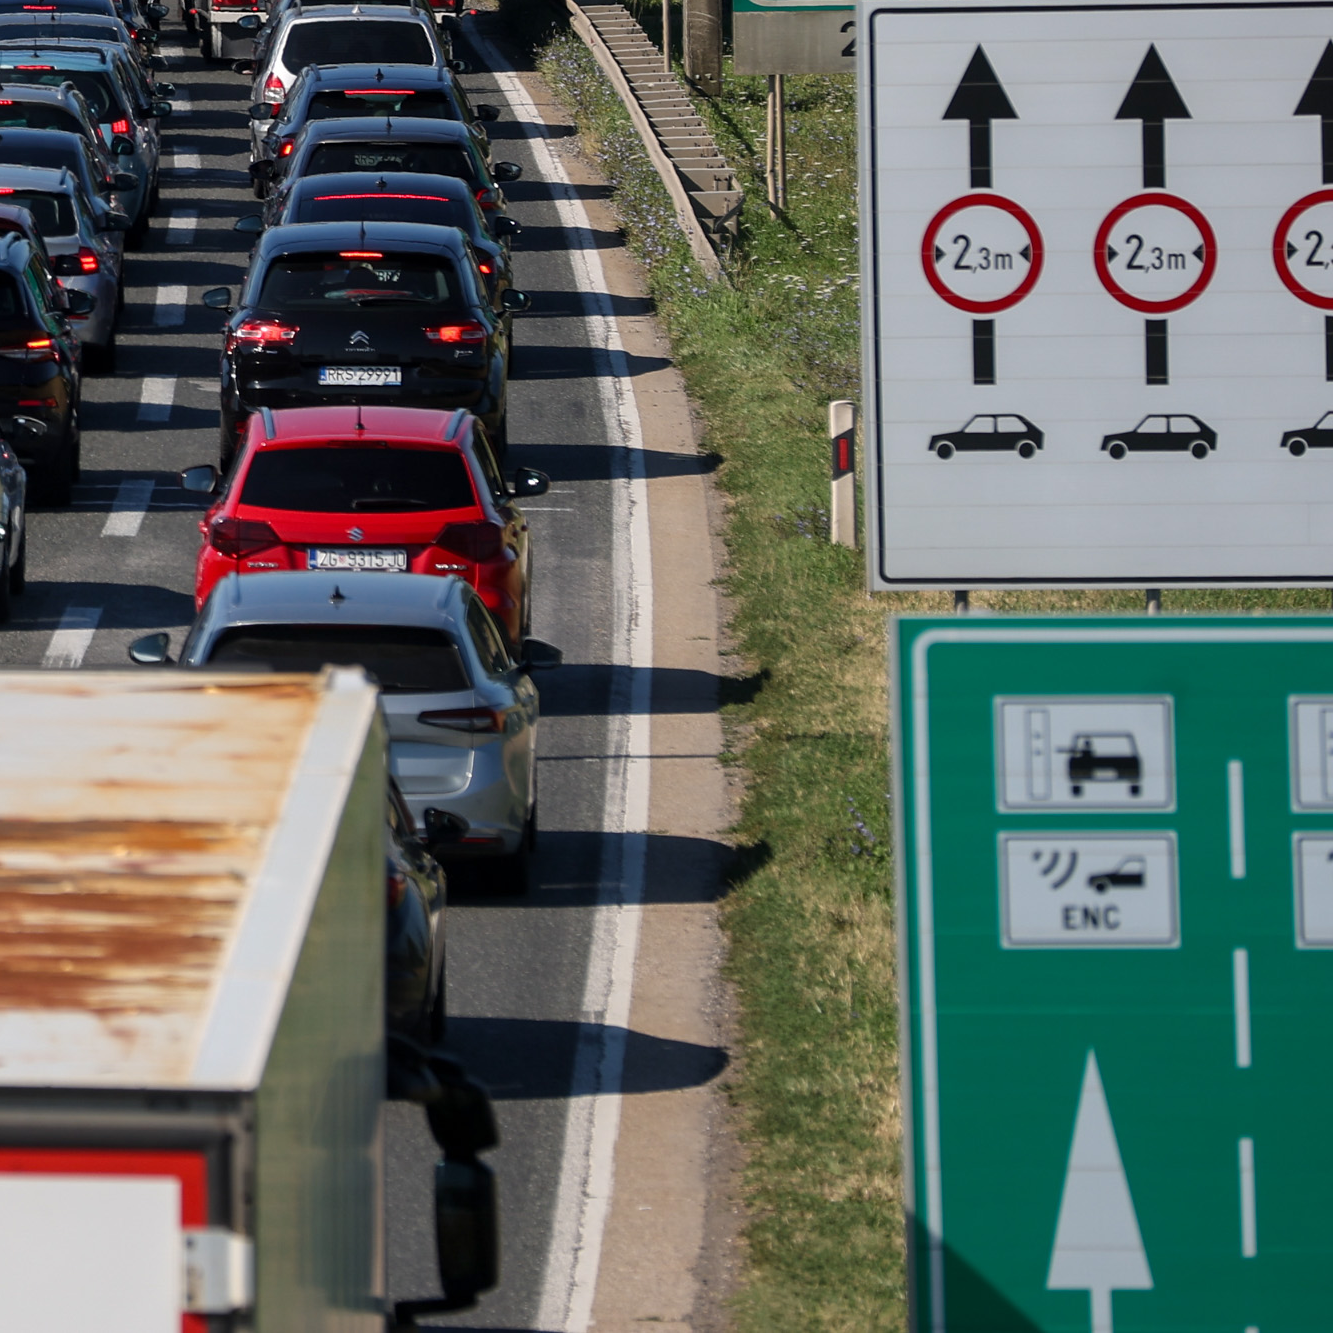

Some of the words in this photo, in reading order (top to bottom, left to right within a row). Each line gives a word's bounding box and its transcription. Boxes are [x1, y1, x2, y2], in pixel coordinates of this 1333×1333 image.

[328, 367, 353, 381] RRS
[358, 367, 398, 381] 29991
[319, 551, 337, 566] ZG
[1061, 904, 1121, 931] ENC
